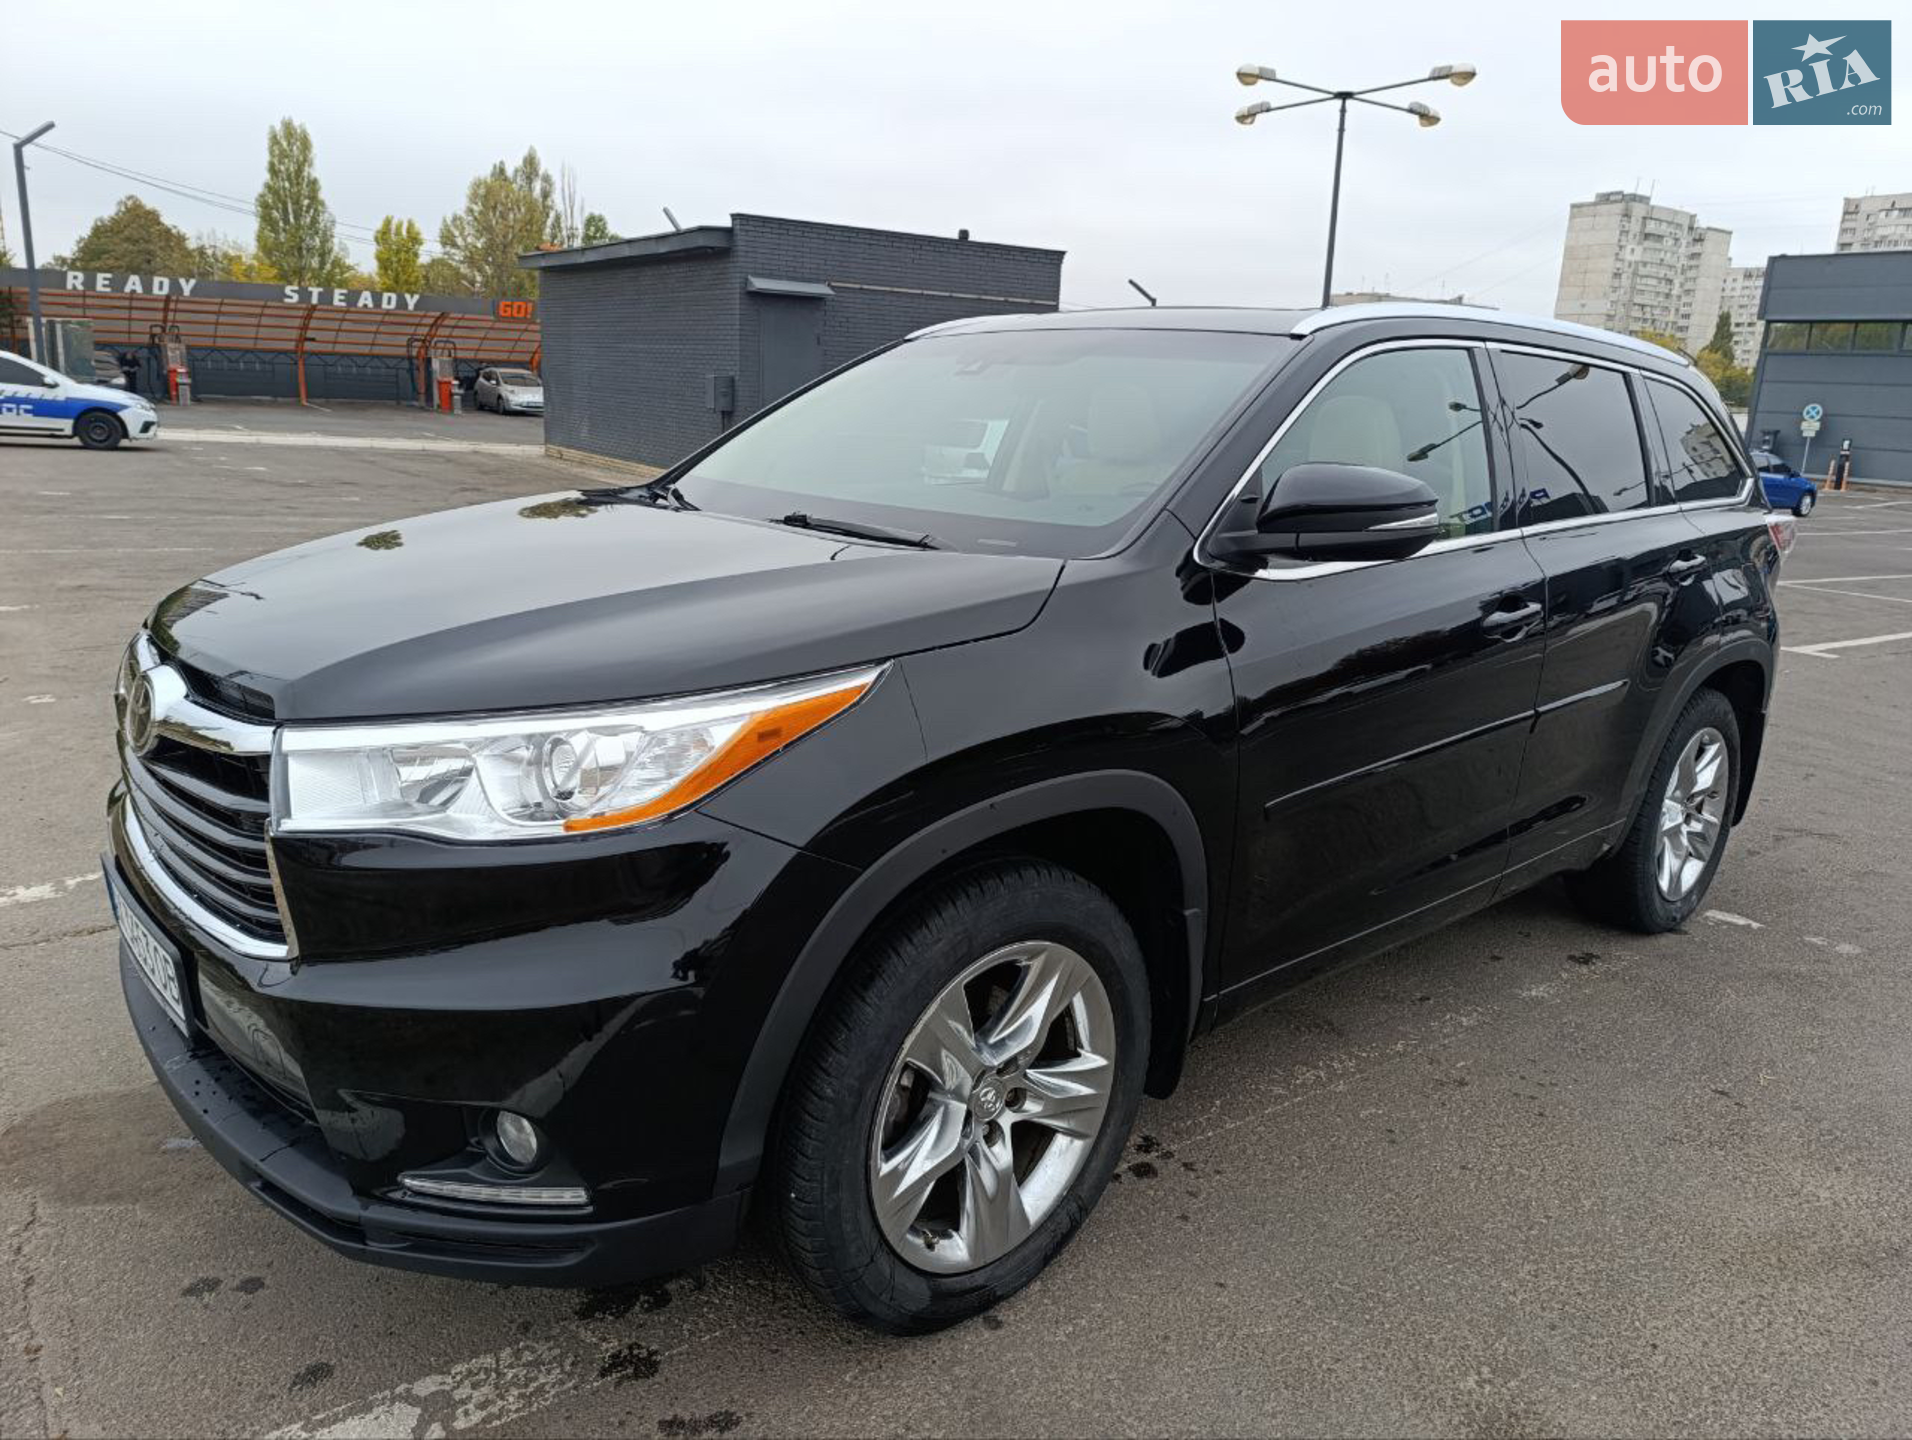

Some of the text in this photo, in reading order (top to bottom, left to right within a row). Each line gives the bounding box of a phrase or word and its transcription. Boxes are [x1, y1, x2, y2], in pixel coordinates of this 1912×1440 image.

[65, 270, 534, 319] READY STEADY GO!
